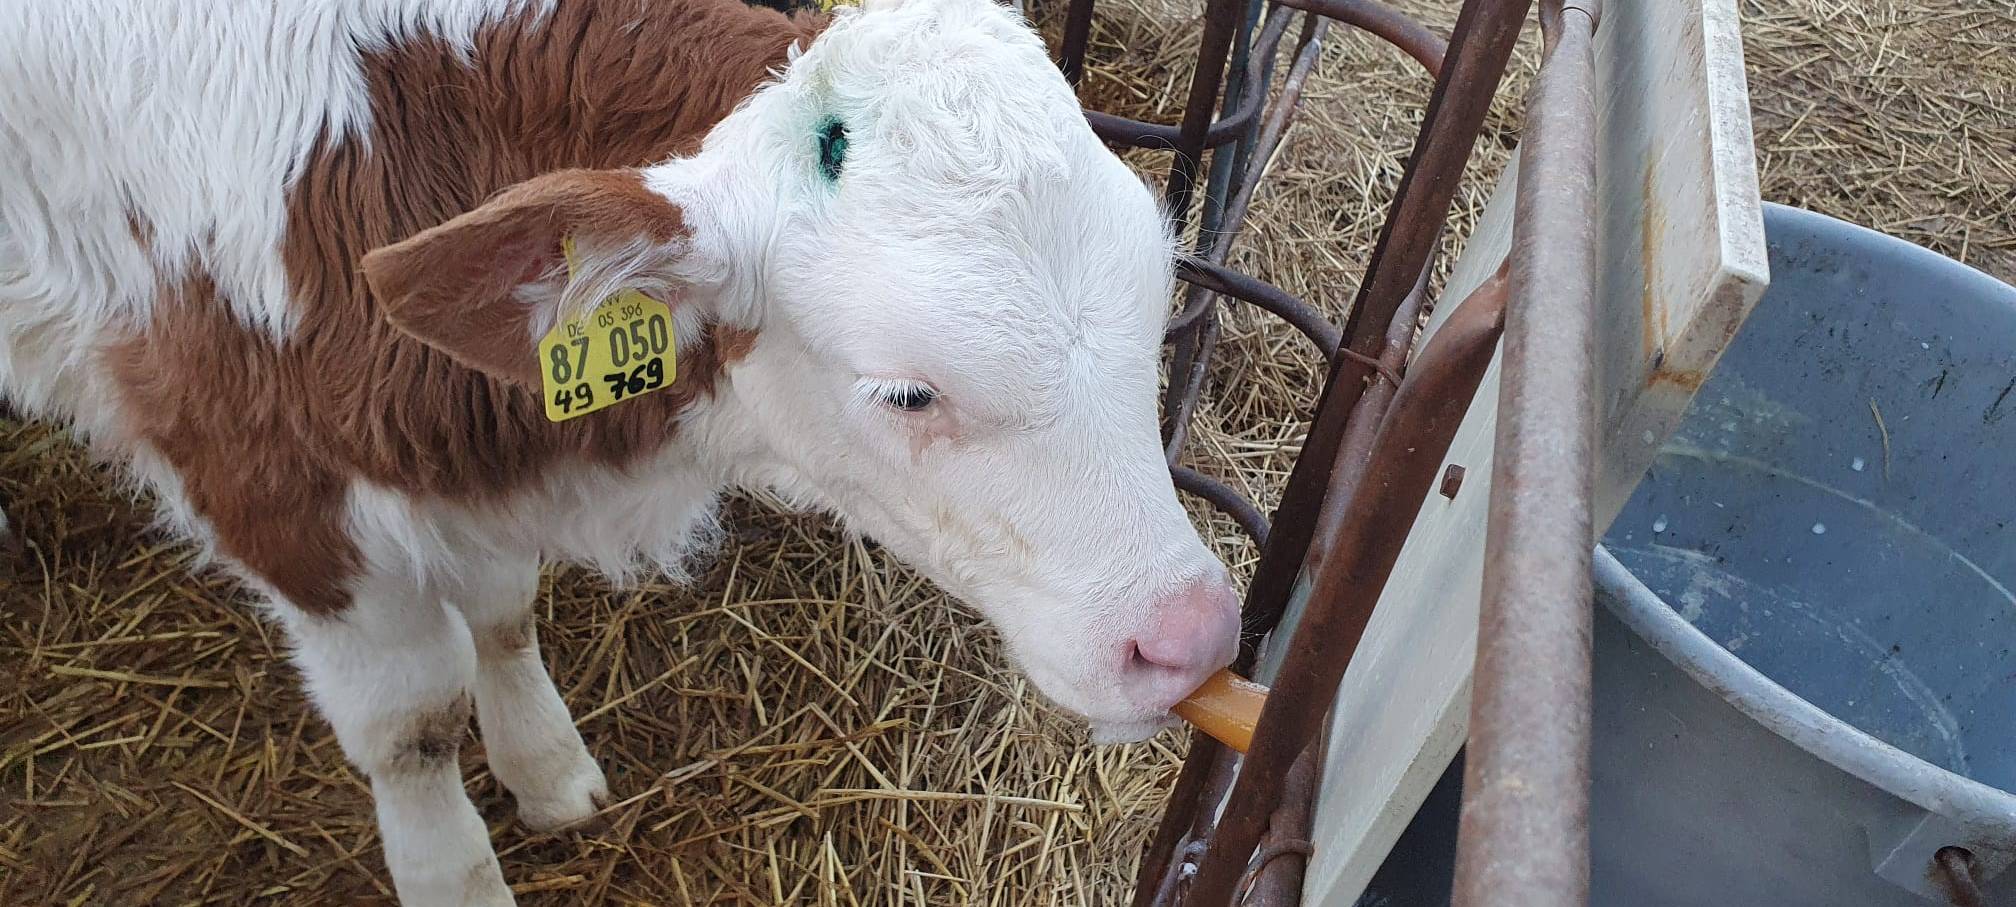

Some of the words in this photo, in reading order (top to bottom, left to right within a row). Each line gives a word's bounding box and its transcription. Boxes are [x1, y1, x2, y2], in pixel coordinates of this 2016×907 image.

[598, 311, 614, 328] 05
[620, 302, 643, 321] 396
[550, 336, 589, 384] 87
[609, 314, 668, 367] 050
[554, 382, 594, 413] 49
[603, 357, 664, 400] 769
